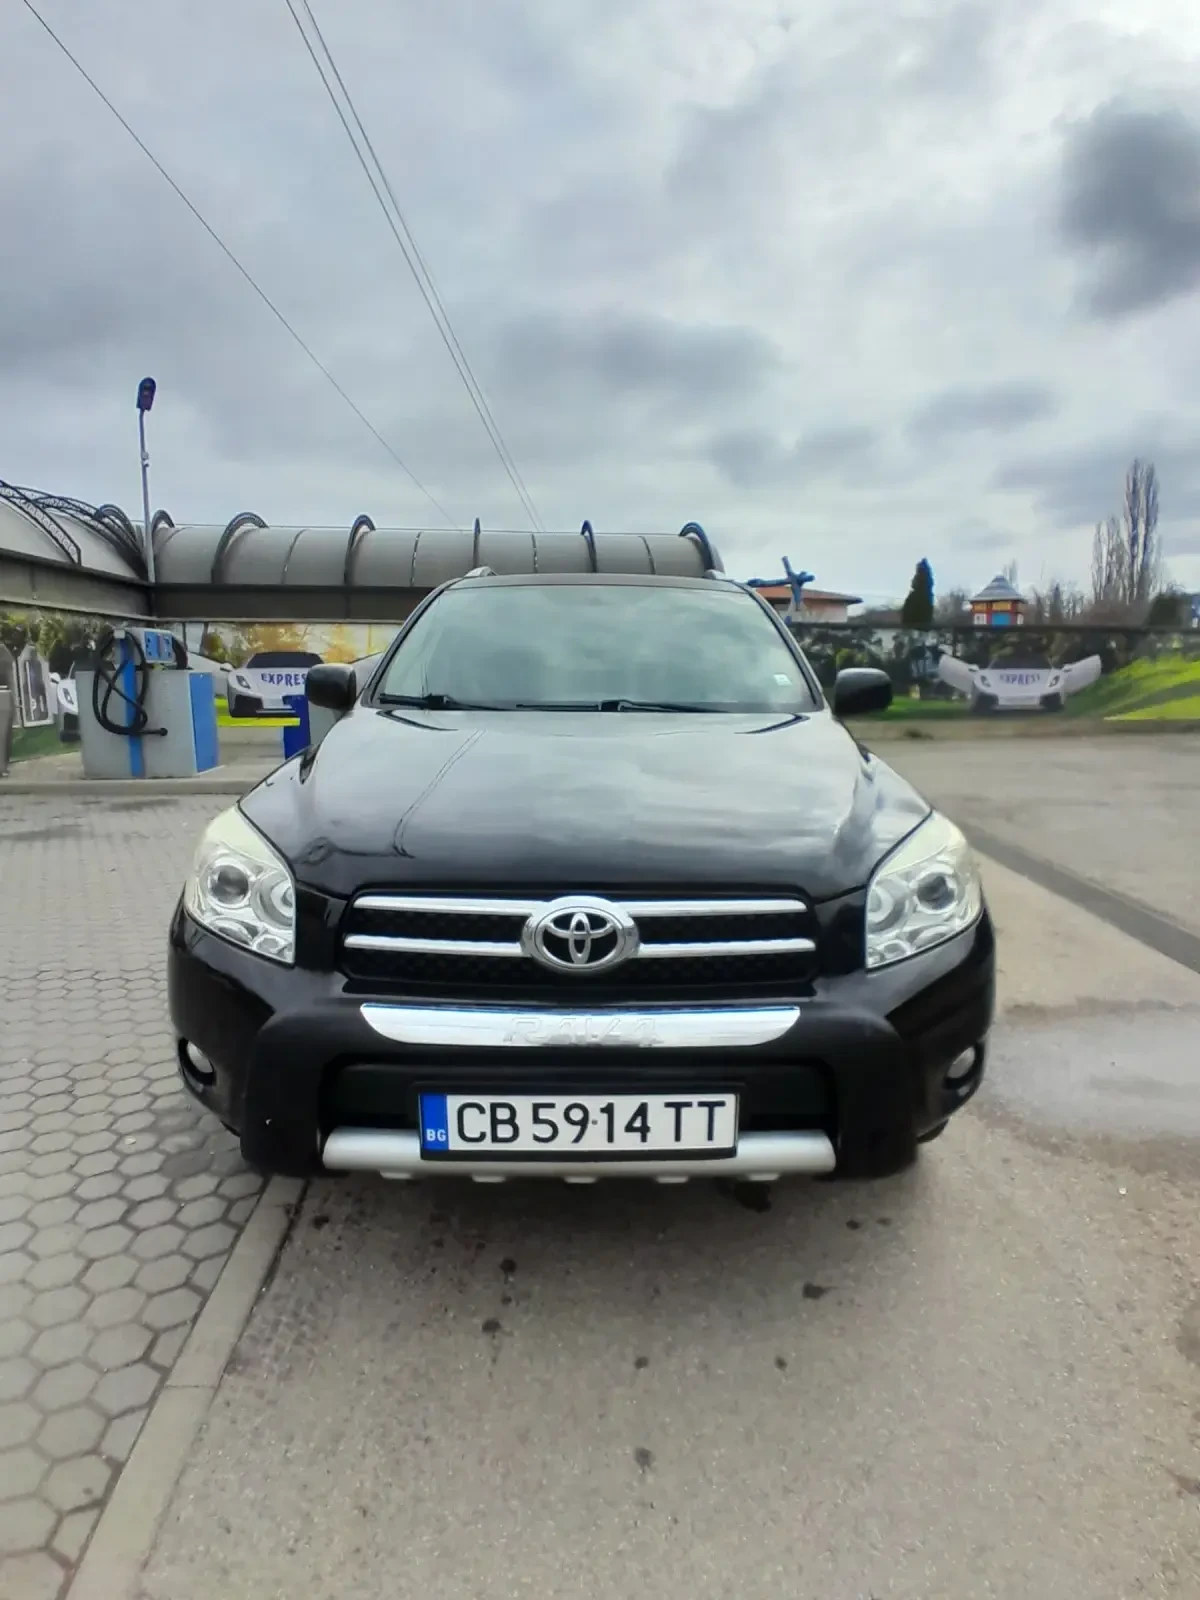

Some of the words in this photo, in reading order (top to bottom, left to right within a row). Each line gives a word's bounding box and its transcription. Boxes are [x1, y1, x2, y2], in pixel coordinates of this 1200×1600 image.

[426, 1129, 447, 1142] BG
[457, 1102, 520, 1144] CB
[532, 1102, 651, 1144] 5914
[664, 1101, 726, 1142] TT
